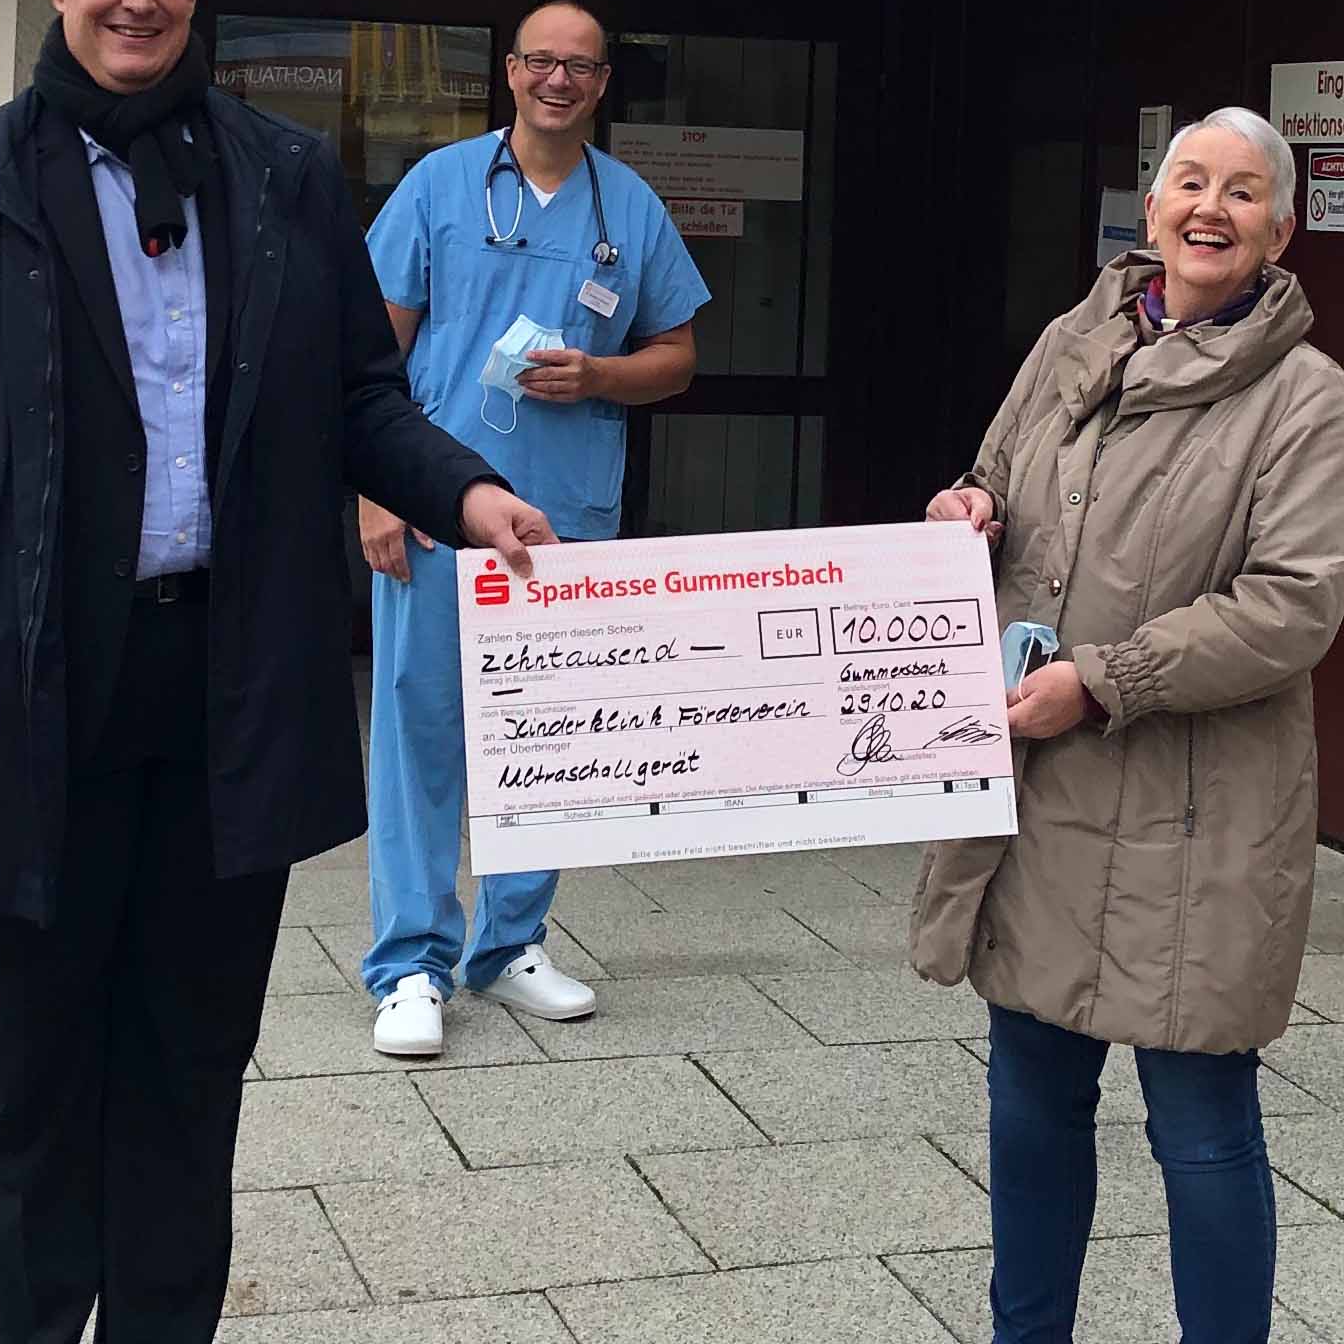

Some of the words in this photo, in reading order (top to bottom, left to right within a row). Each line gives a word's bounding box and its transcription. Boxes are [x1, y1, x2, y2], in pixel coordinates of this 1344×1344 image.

[681, 131, 707, 143] STOP
[526, 576, 656, 607] Sparkasse
[664, 561, 843, 595] Gummersbach
[477, 633, 513, 644] Zahlen
[515, 631, 533, 642] Sie
[535, 630, 568, 643] gegen
[570, 627, 604, 638] diesen
[607, 624, 645, 635] Scheck
[776, 628, 804, 640] EUR
[843, 614, 966, 644] 10.000,-
[840, 659, 949, 682] Gummersbach
[482, 733, 496, 742] an
[483, 746, 507, 757] oder
[509, 741, 572, 756] Überbringer
